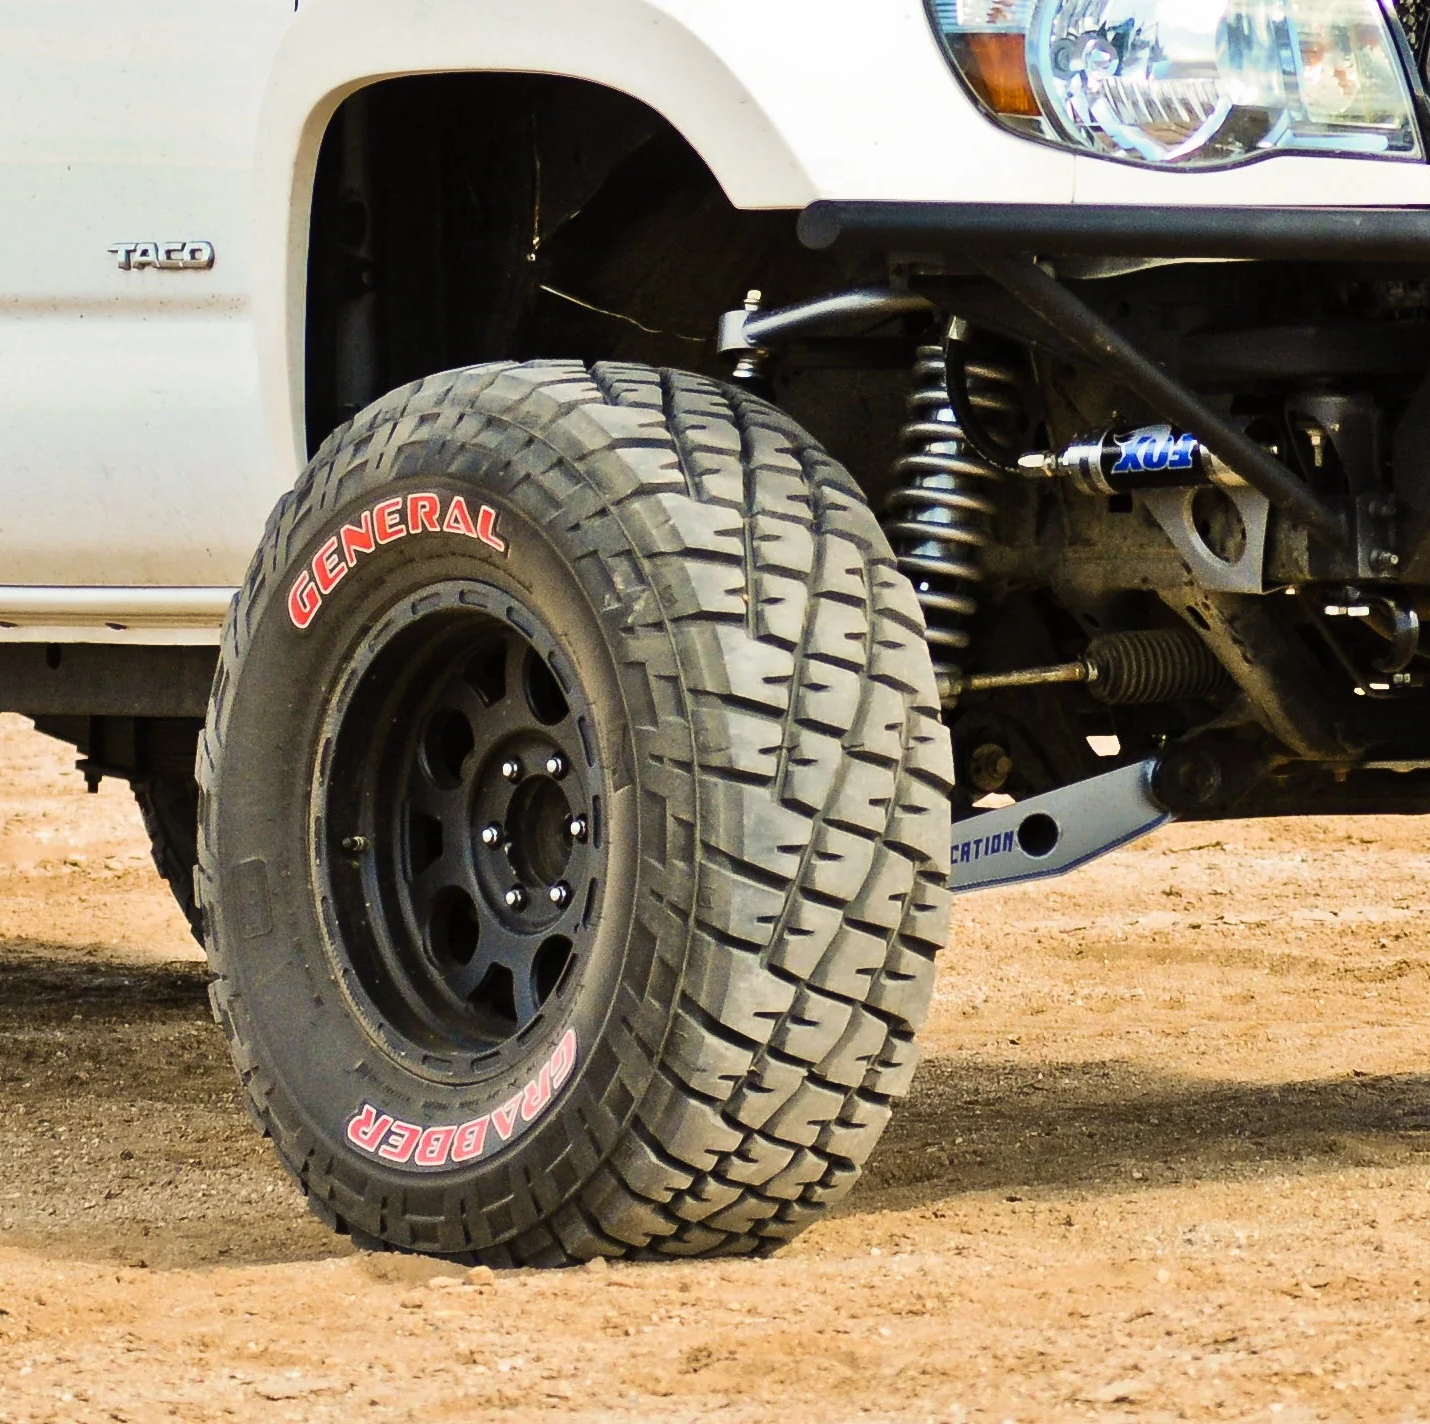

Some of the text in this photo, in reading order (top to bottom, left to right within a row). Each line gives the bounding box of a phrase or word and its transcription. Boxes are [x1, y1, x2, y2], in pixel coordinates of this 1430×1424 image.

[106, 240, 216, 271] TACO
[1111, 429, 1199, 474] FOX
[287, 490, 510, 629] GENERAL
[347, 1026, 578, 1167] GRABBER
